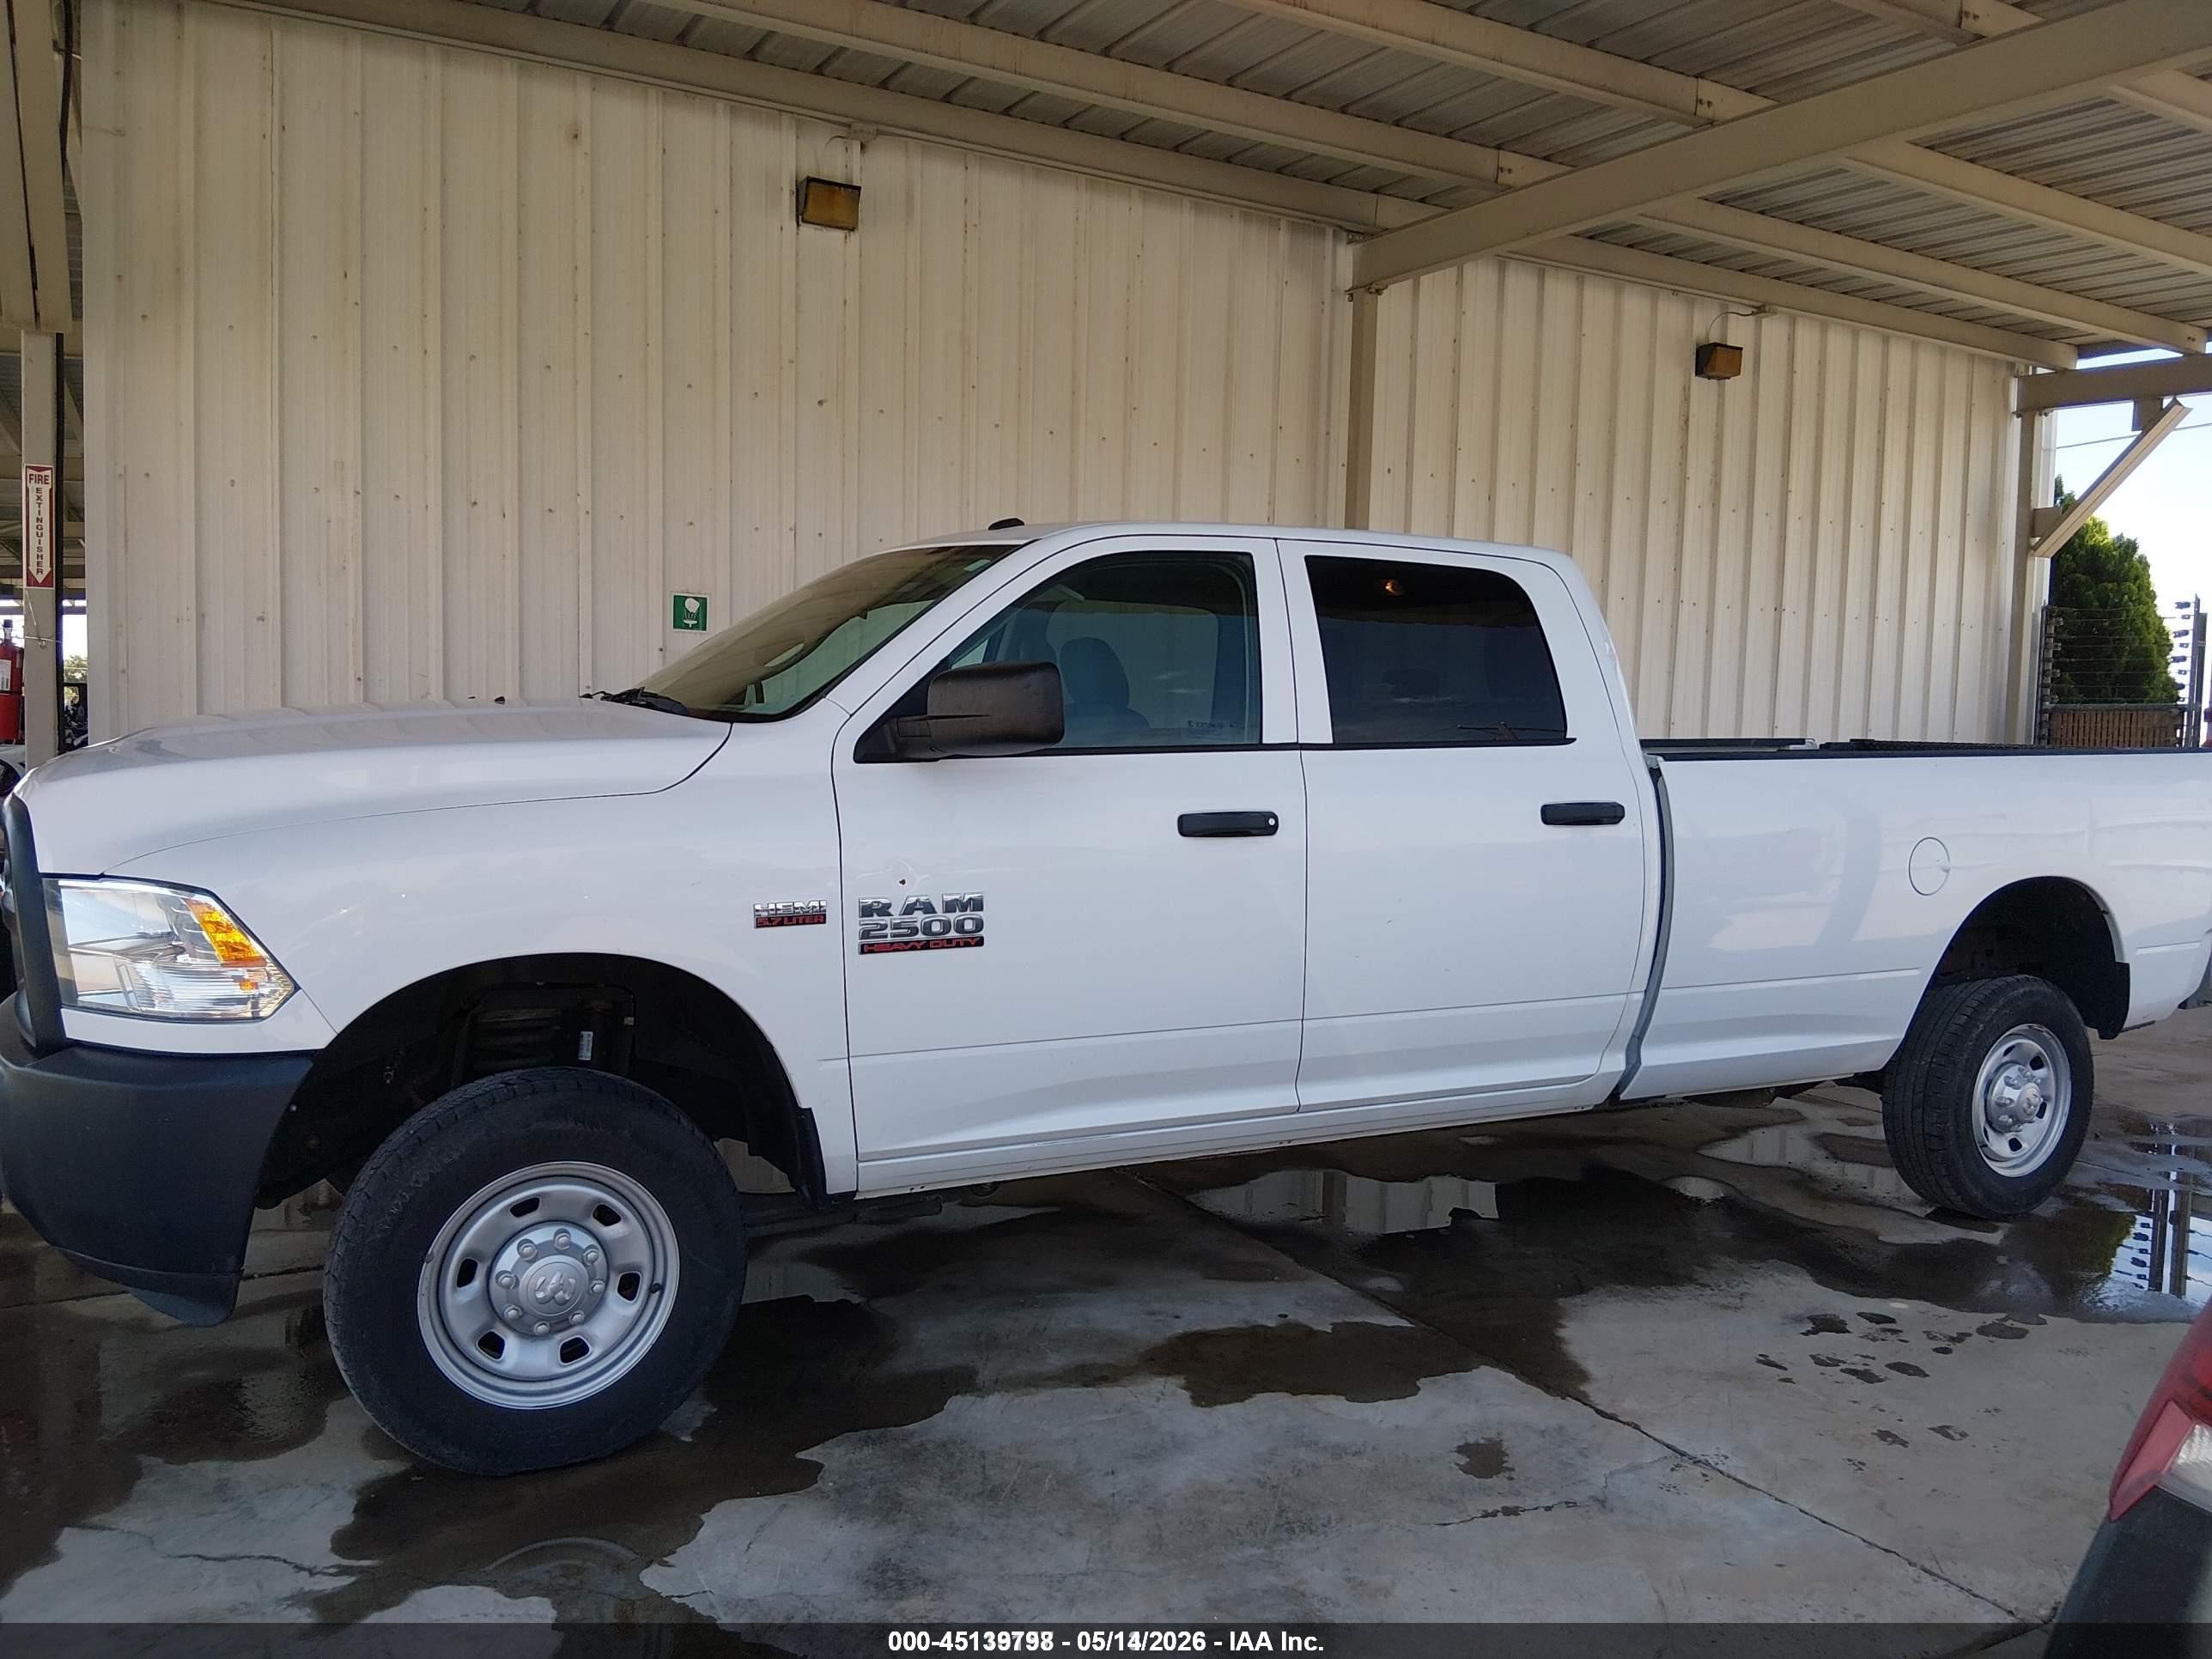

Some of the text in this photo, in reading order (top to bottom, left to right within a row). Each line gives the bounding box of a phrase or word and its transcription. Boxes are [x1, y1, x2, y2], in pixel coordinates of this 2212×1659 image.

[28, 473, 50, 485] FIRE
[35, 487, 44, 574] EXTINGUISHER
[753, 900, 827, 916] HEMI
[859, 892, 984, 918] RAM
[757, 915, 825, 927] 5.7 LITER
[859, 914, 984, 940] 2500
[864, 937, 981, 953] HEAVY DUTY
